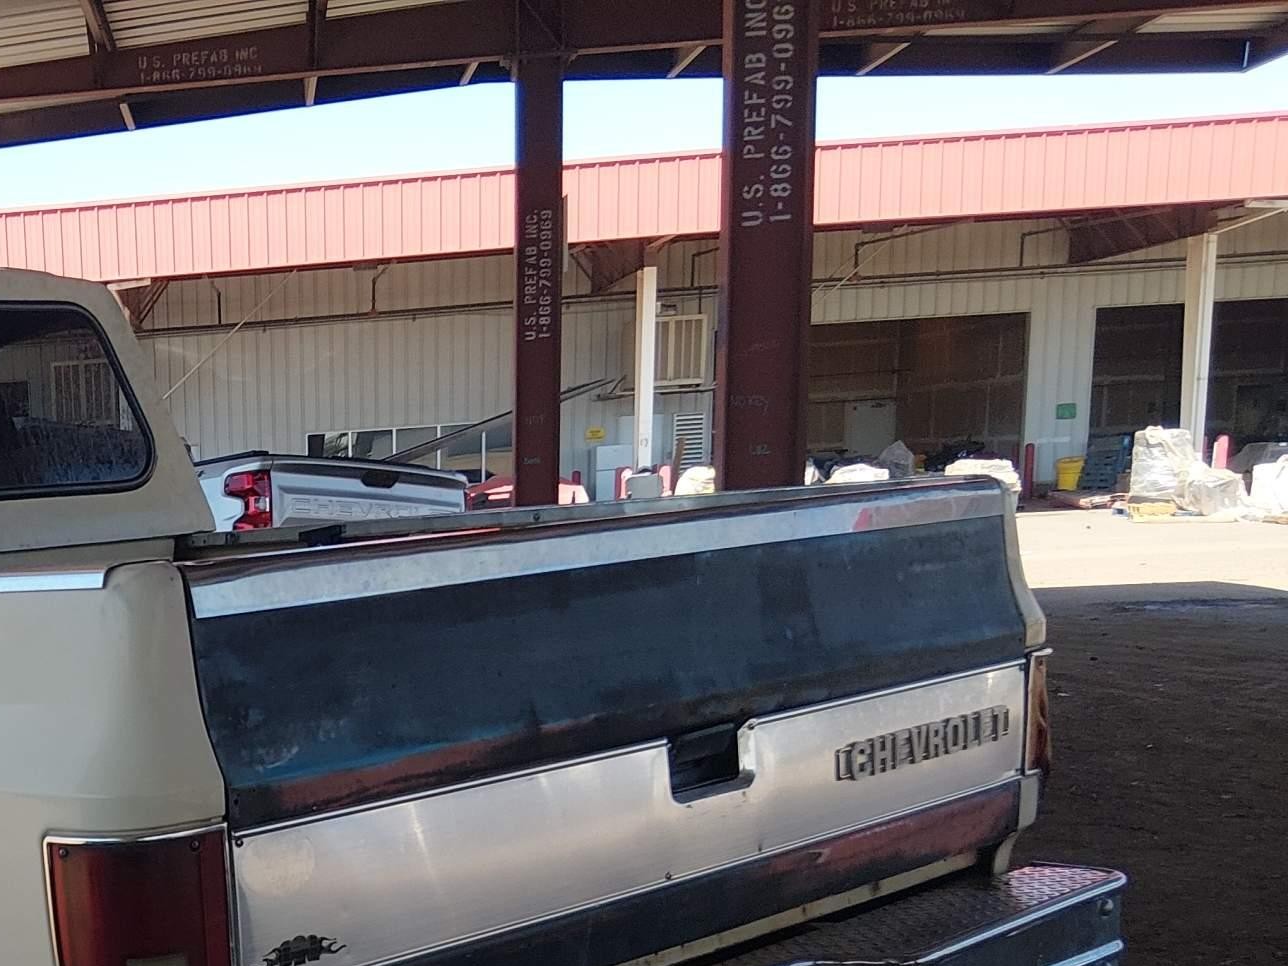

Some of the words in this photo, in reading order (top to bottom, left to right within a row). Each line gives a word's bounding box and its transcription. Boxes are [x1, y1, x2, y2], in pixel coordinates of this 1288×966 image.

[172, 49, 229, 67] PREFAB
[743, 52, 767, 159] PREFAB
[769, 0, 795, 223] 1-866-799-096
[525, 209, 539, 239] INC.
[741, 176, 764, 227] U.S.
[524, 246, 537, 305] PREFAB
[538, 209, 553, 338] 1-866-799-0969
[524, 312, 537, 341] U.S.
[838, 704, 1010, 780] CHEVROLET
